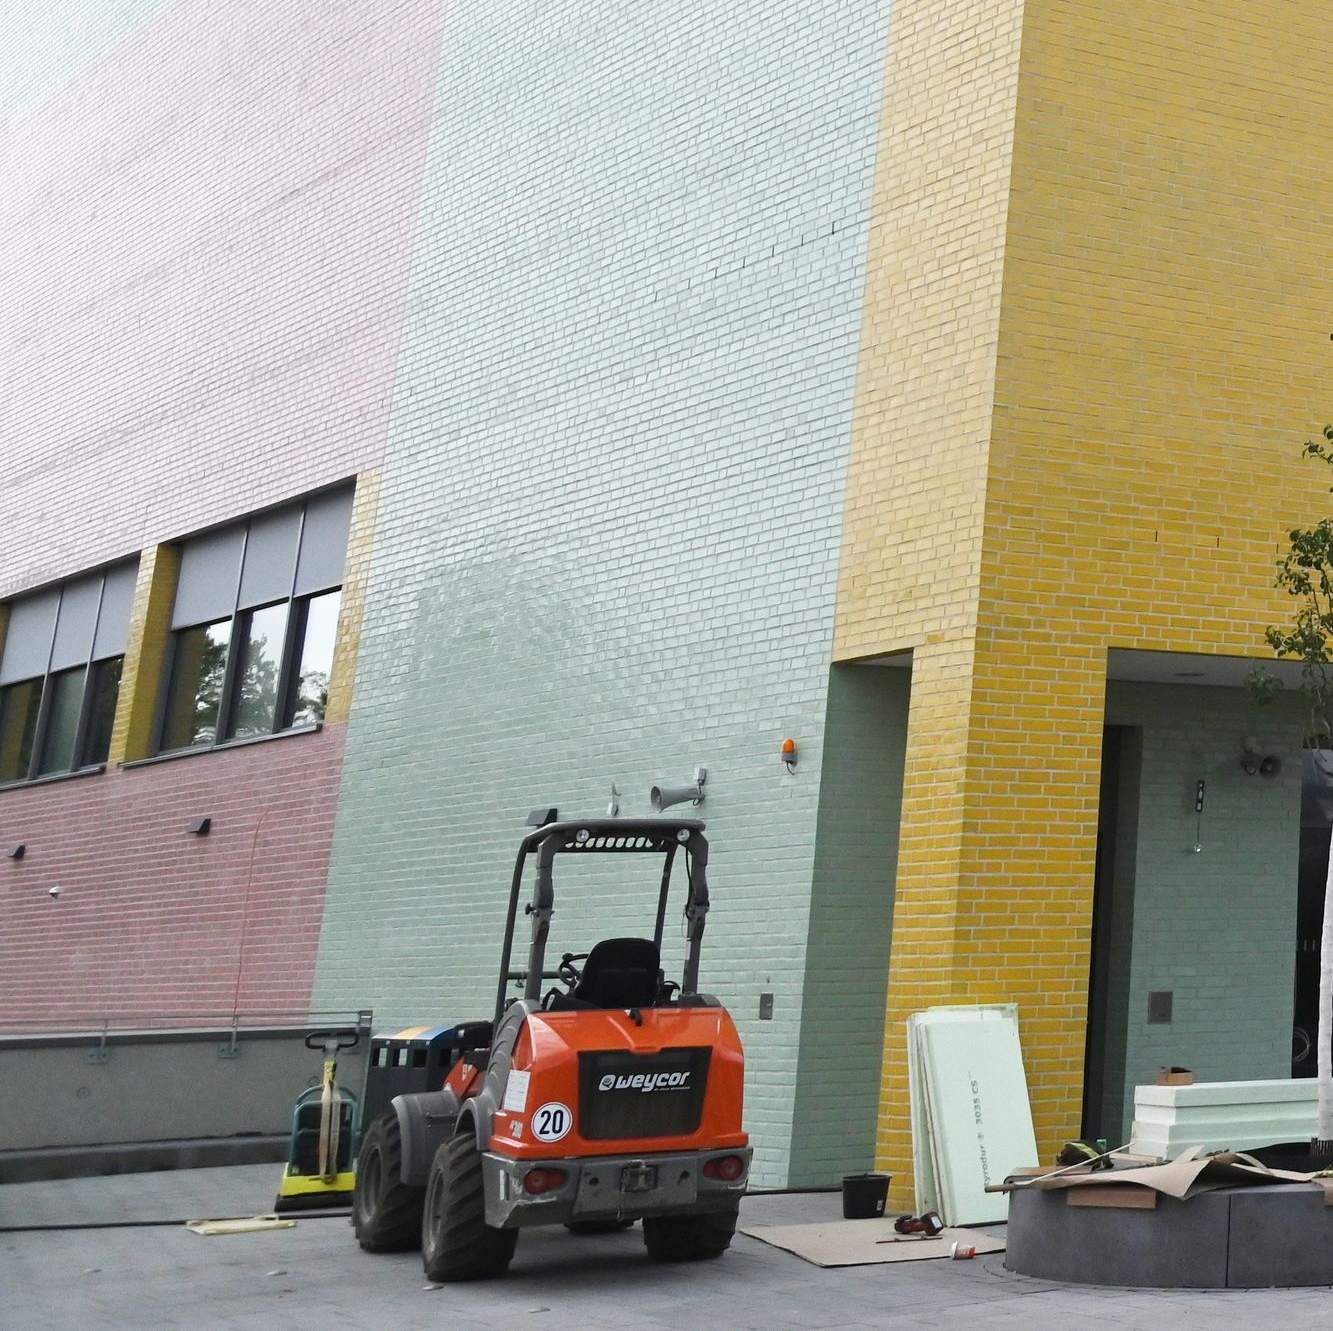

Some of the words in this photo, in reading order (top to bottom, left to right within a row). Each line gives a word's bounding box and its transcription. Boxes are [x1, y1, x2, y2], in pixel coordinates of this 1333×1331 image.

[614, 1071, 691, 1092] weycor
[971, 1080, 978, 1094] CS
[539, 1108, 564, 1135] 20
[974, 1098, 982, 1124] 3035
[980, 1145, 991, 1189] tyrodur
